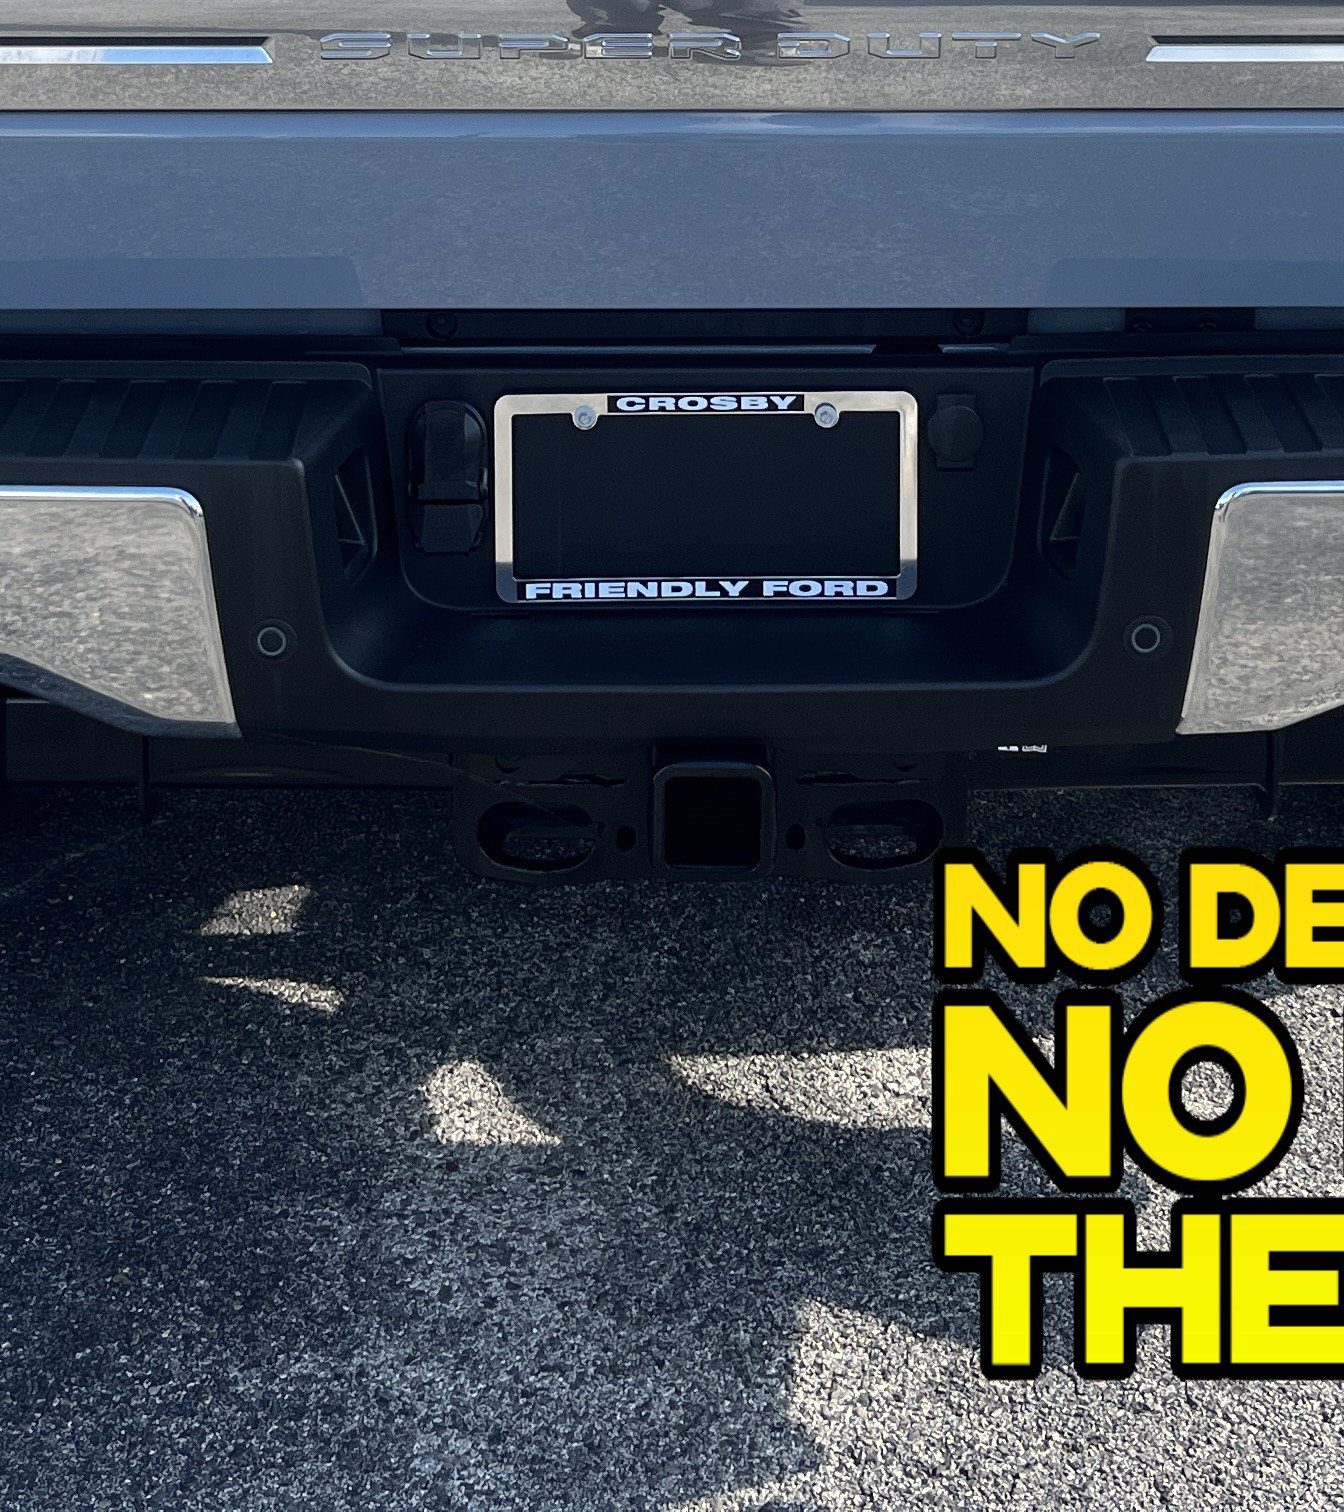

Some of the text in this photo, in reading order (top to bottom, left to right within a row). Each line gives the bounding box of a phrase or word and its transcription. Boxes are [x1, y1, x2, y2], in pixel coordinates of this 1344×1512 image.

[320, 31, 1101, 61] SUPER DUTY
[616, 395, 798, 412] CROSBY
[524, 579, 890, 600] FRIENDLY FORD
